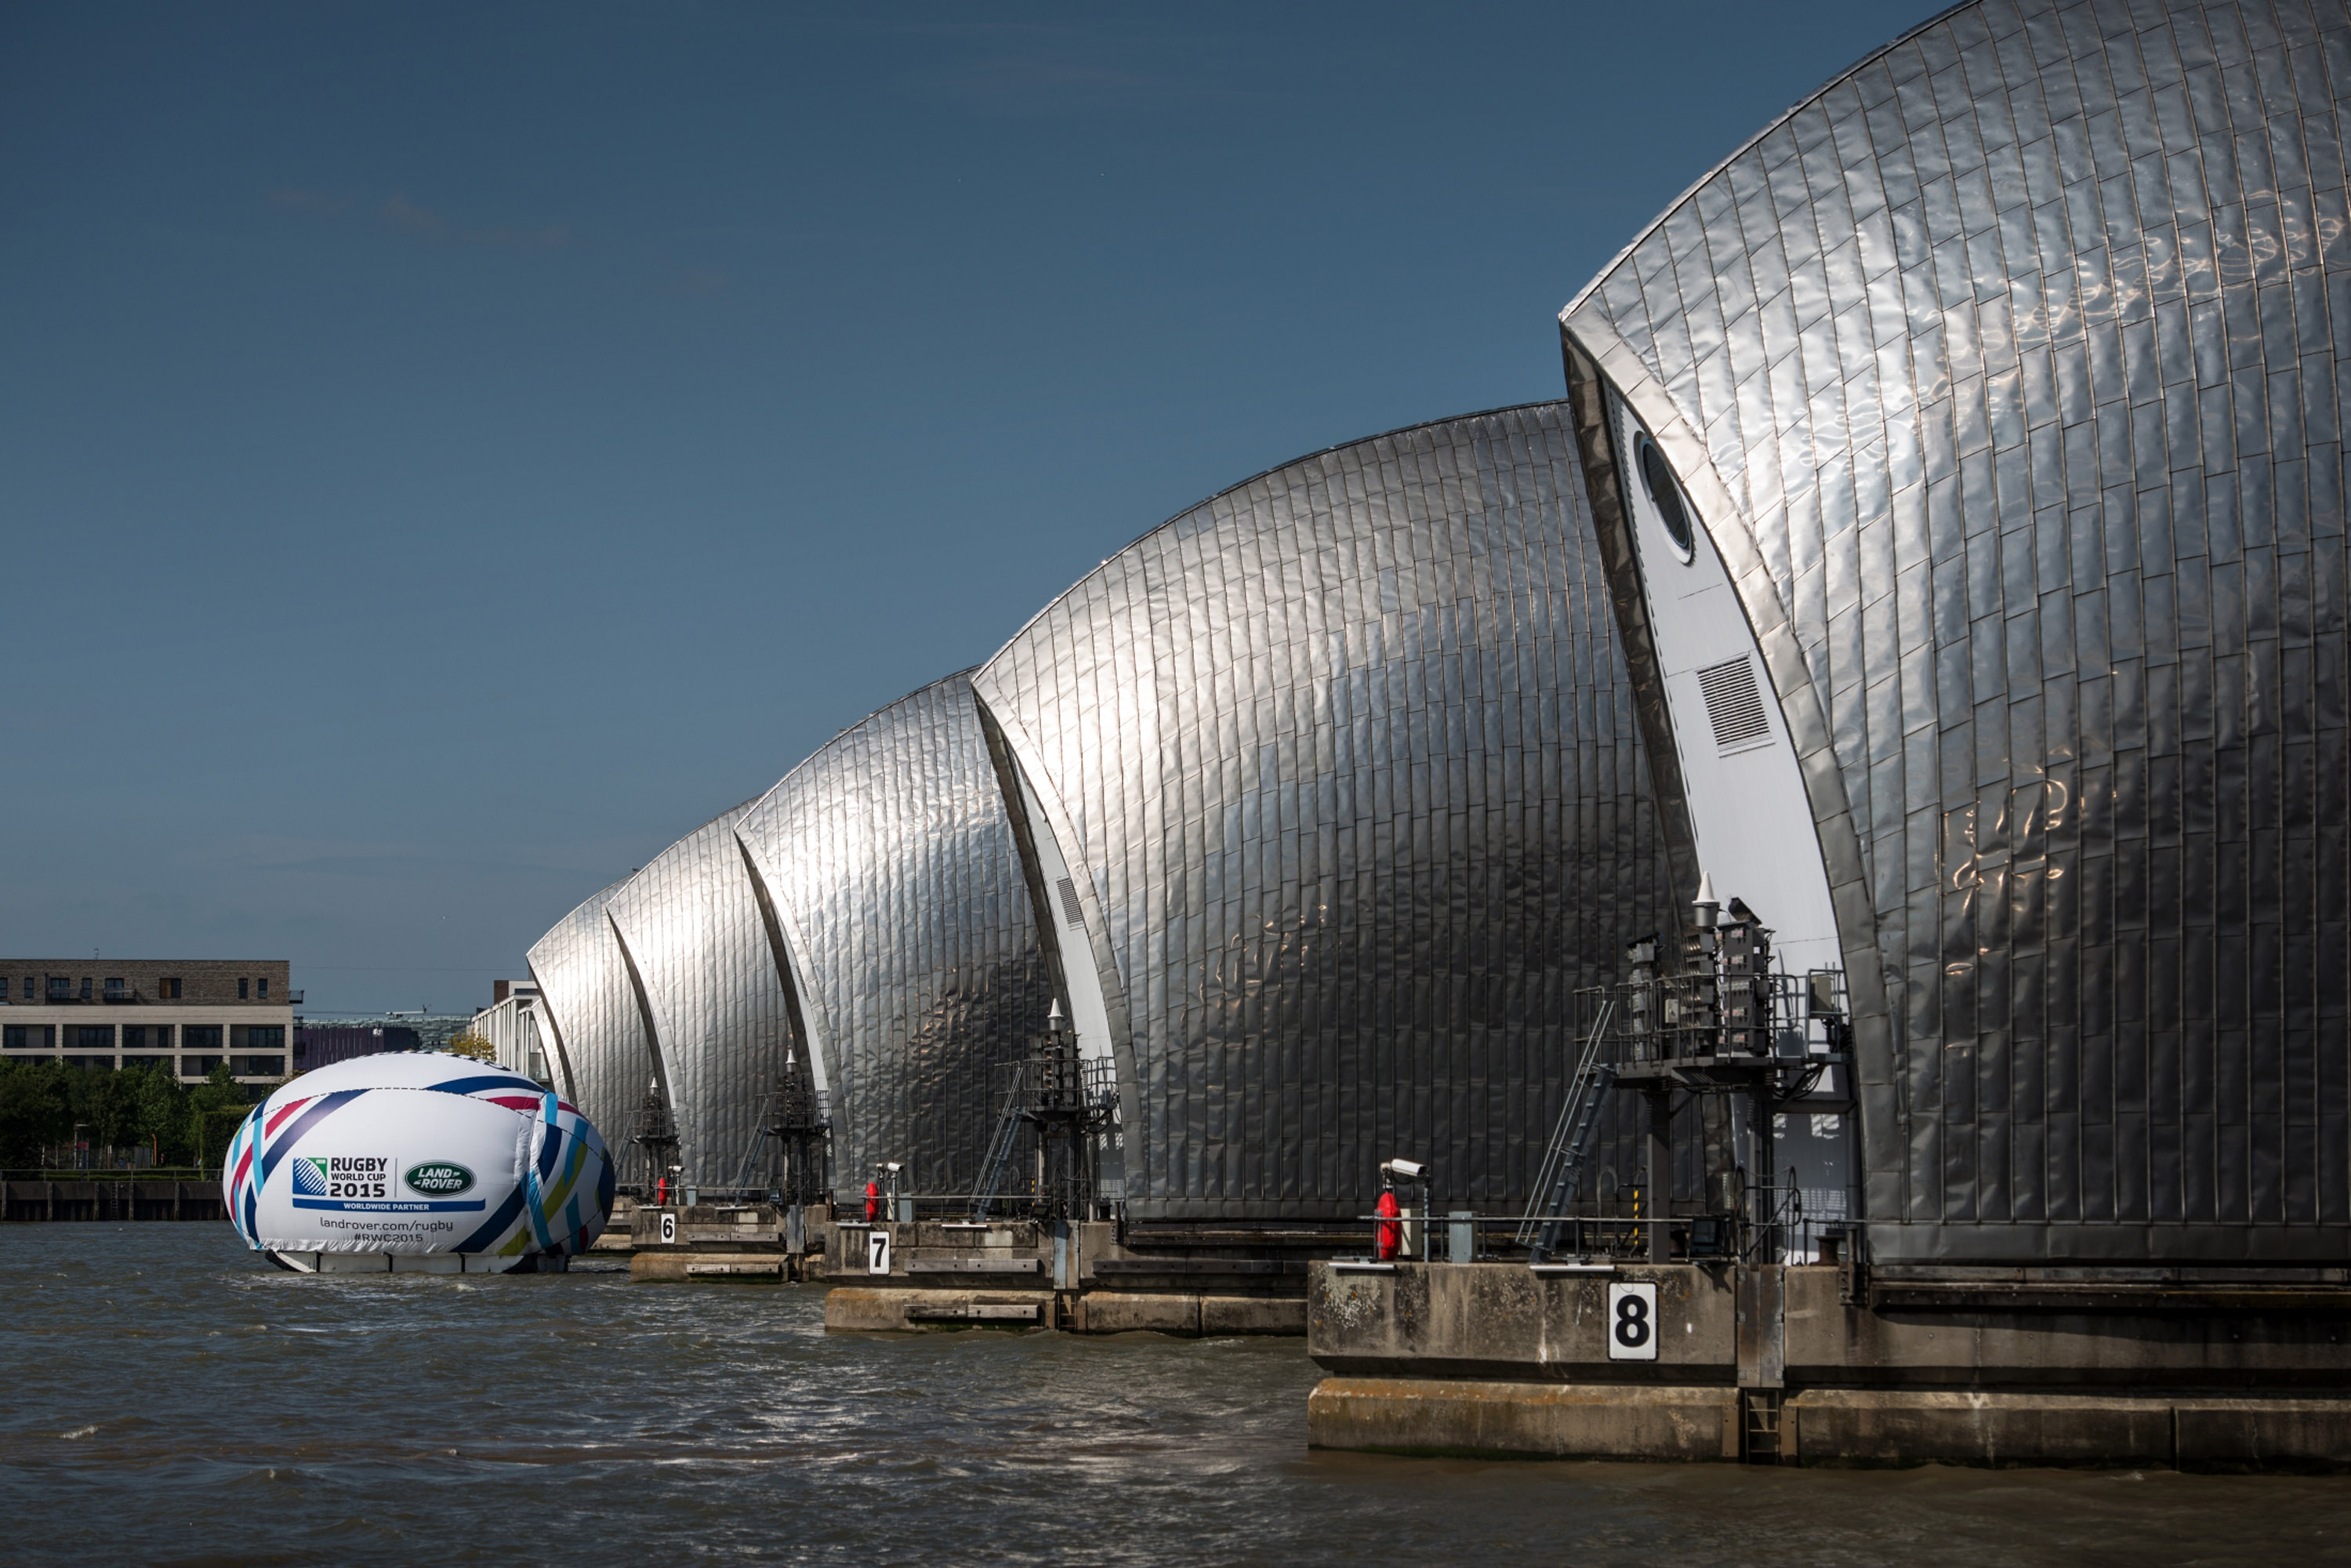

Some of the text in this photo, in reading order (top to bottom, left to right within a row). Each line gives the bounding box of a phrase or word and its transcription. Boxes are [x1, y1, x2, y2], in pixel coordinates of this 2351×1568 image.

[330, 1157, 387, 1172] RUGBY
[418, 1167, 452, 1178] LAND
[330, 1183, 386, 1198] 2015
[420, 1178, 463, 1189] ROVER
[320, 1217, 454, 1232] landrover.com/rugby
[663, 1218, 673, 1239] 6
[354, 1233, 423, 1243] #RWC2015
[873, 1238, 886, 1268] 7
[1616, 1294, 1650, 1348] 8
